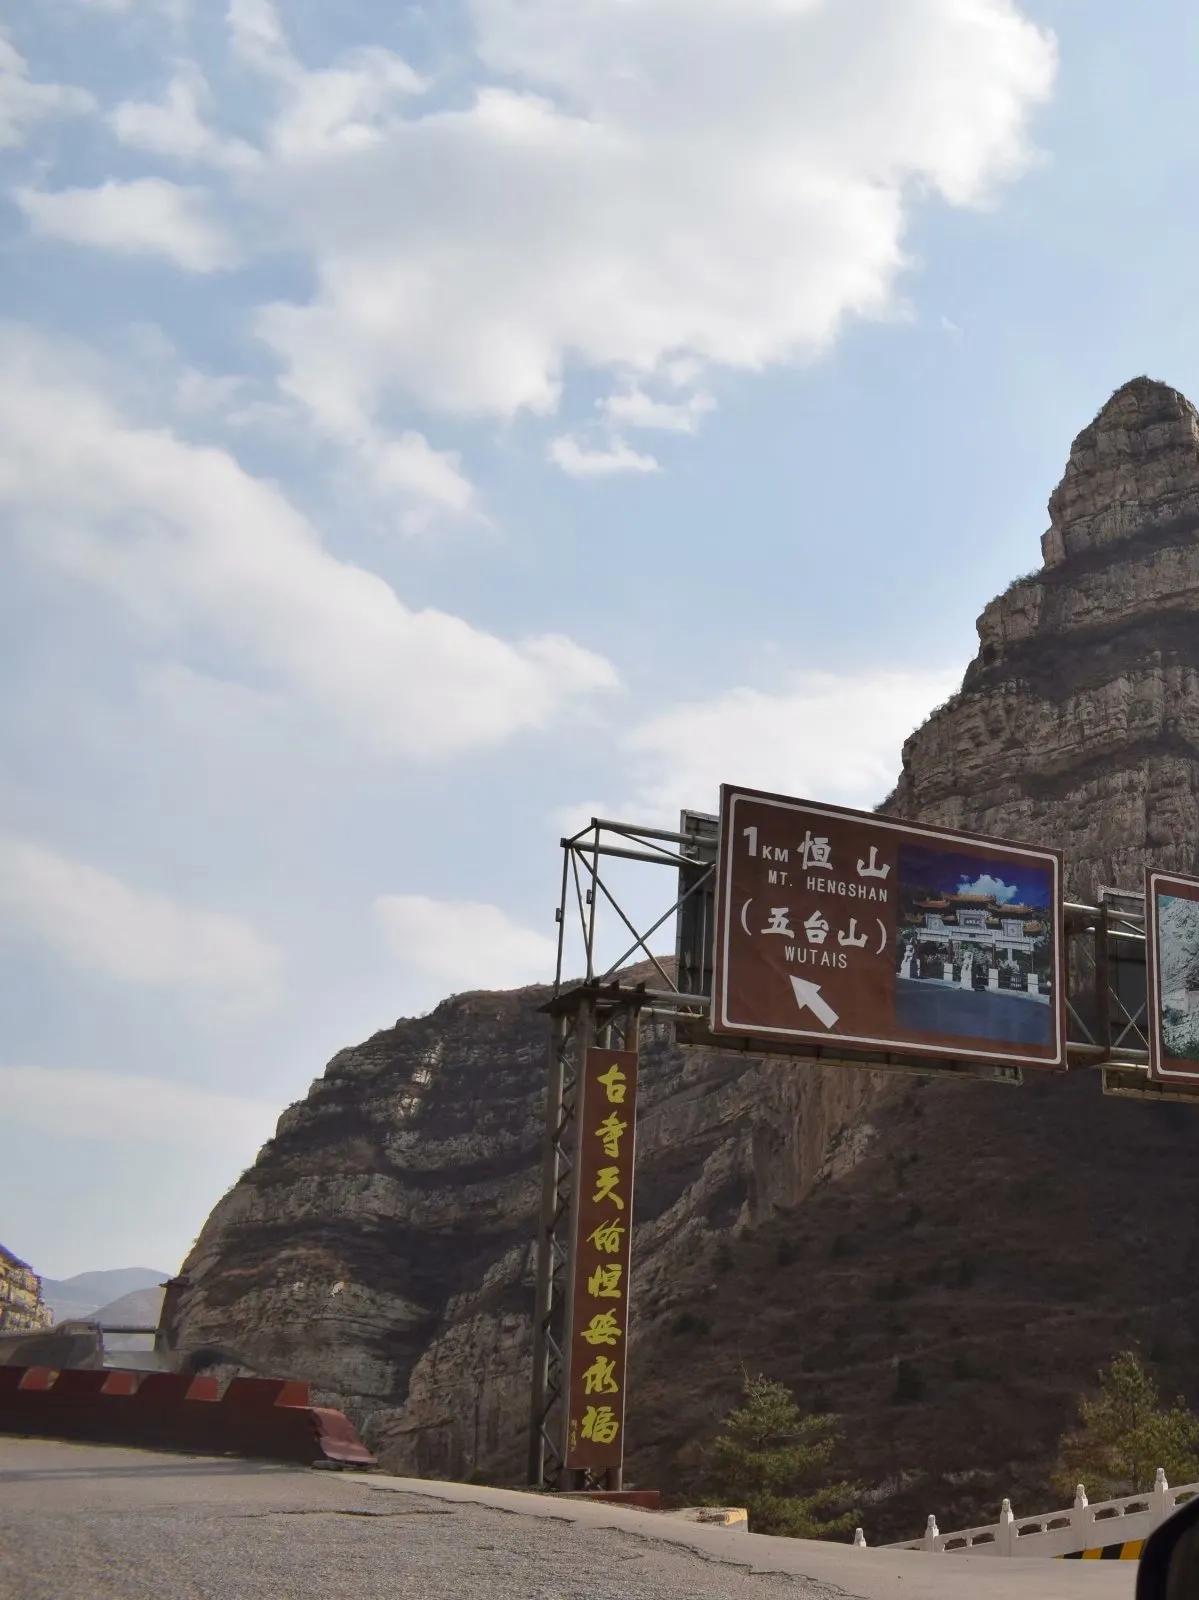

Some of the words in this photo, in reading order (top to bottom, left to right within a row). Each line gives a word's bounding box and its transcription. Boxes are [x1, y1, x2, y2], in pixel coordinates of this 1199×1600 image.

[797, 830, 891, 880] 恒山
[768, 869, 793, 887] MT.
[806, 876, 888, 903] HENGSHAN
[784, 945, 848, 969] WUTAIS
